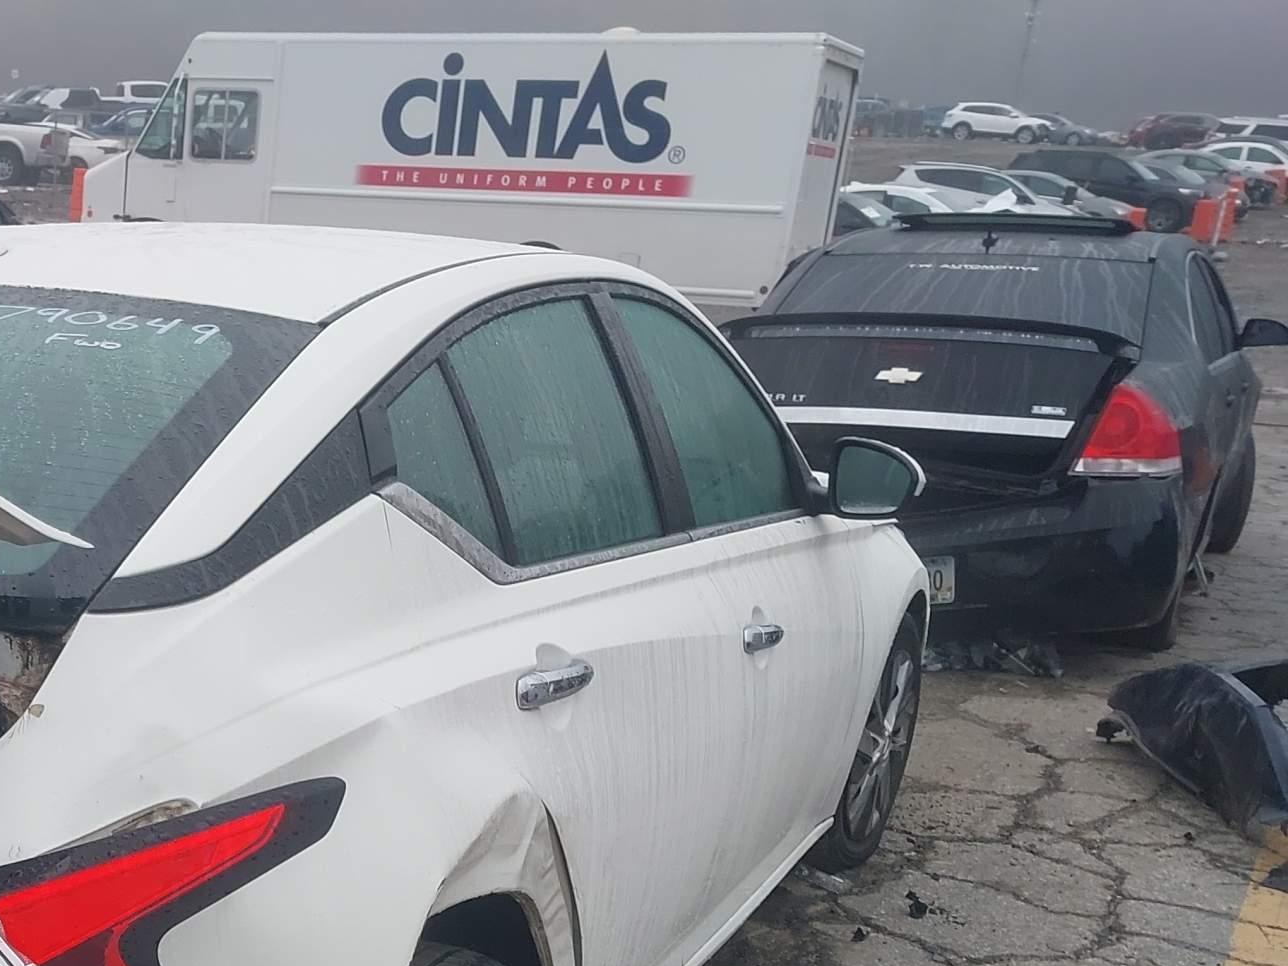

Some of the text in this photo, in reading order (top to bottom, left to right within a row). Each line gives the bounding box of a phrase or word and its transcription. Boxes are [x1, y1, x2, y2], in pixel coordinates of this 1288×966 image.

[381, 49, 671, 163] CINTAS
[381, 170, 663, 192] THE UNIFORM PEOPLE
